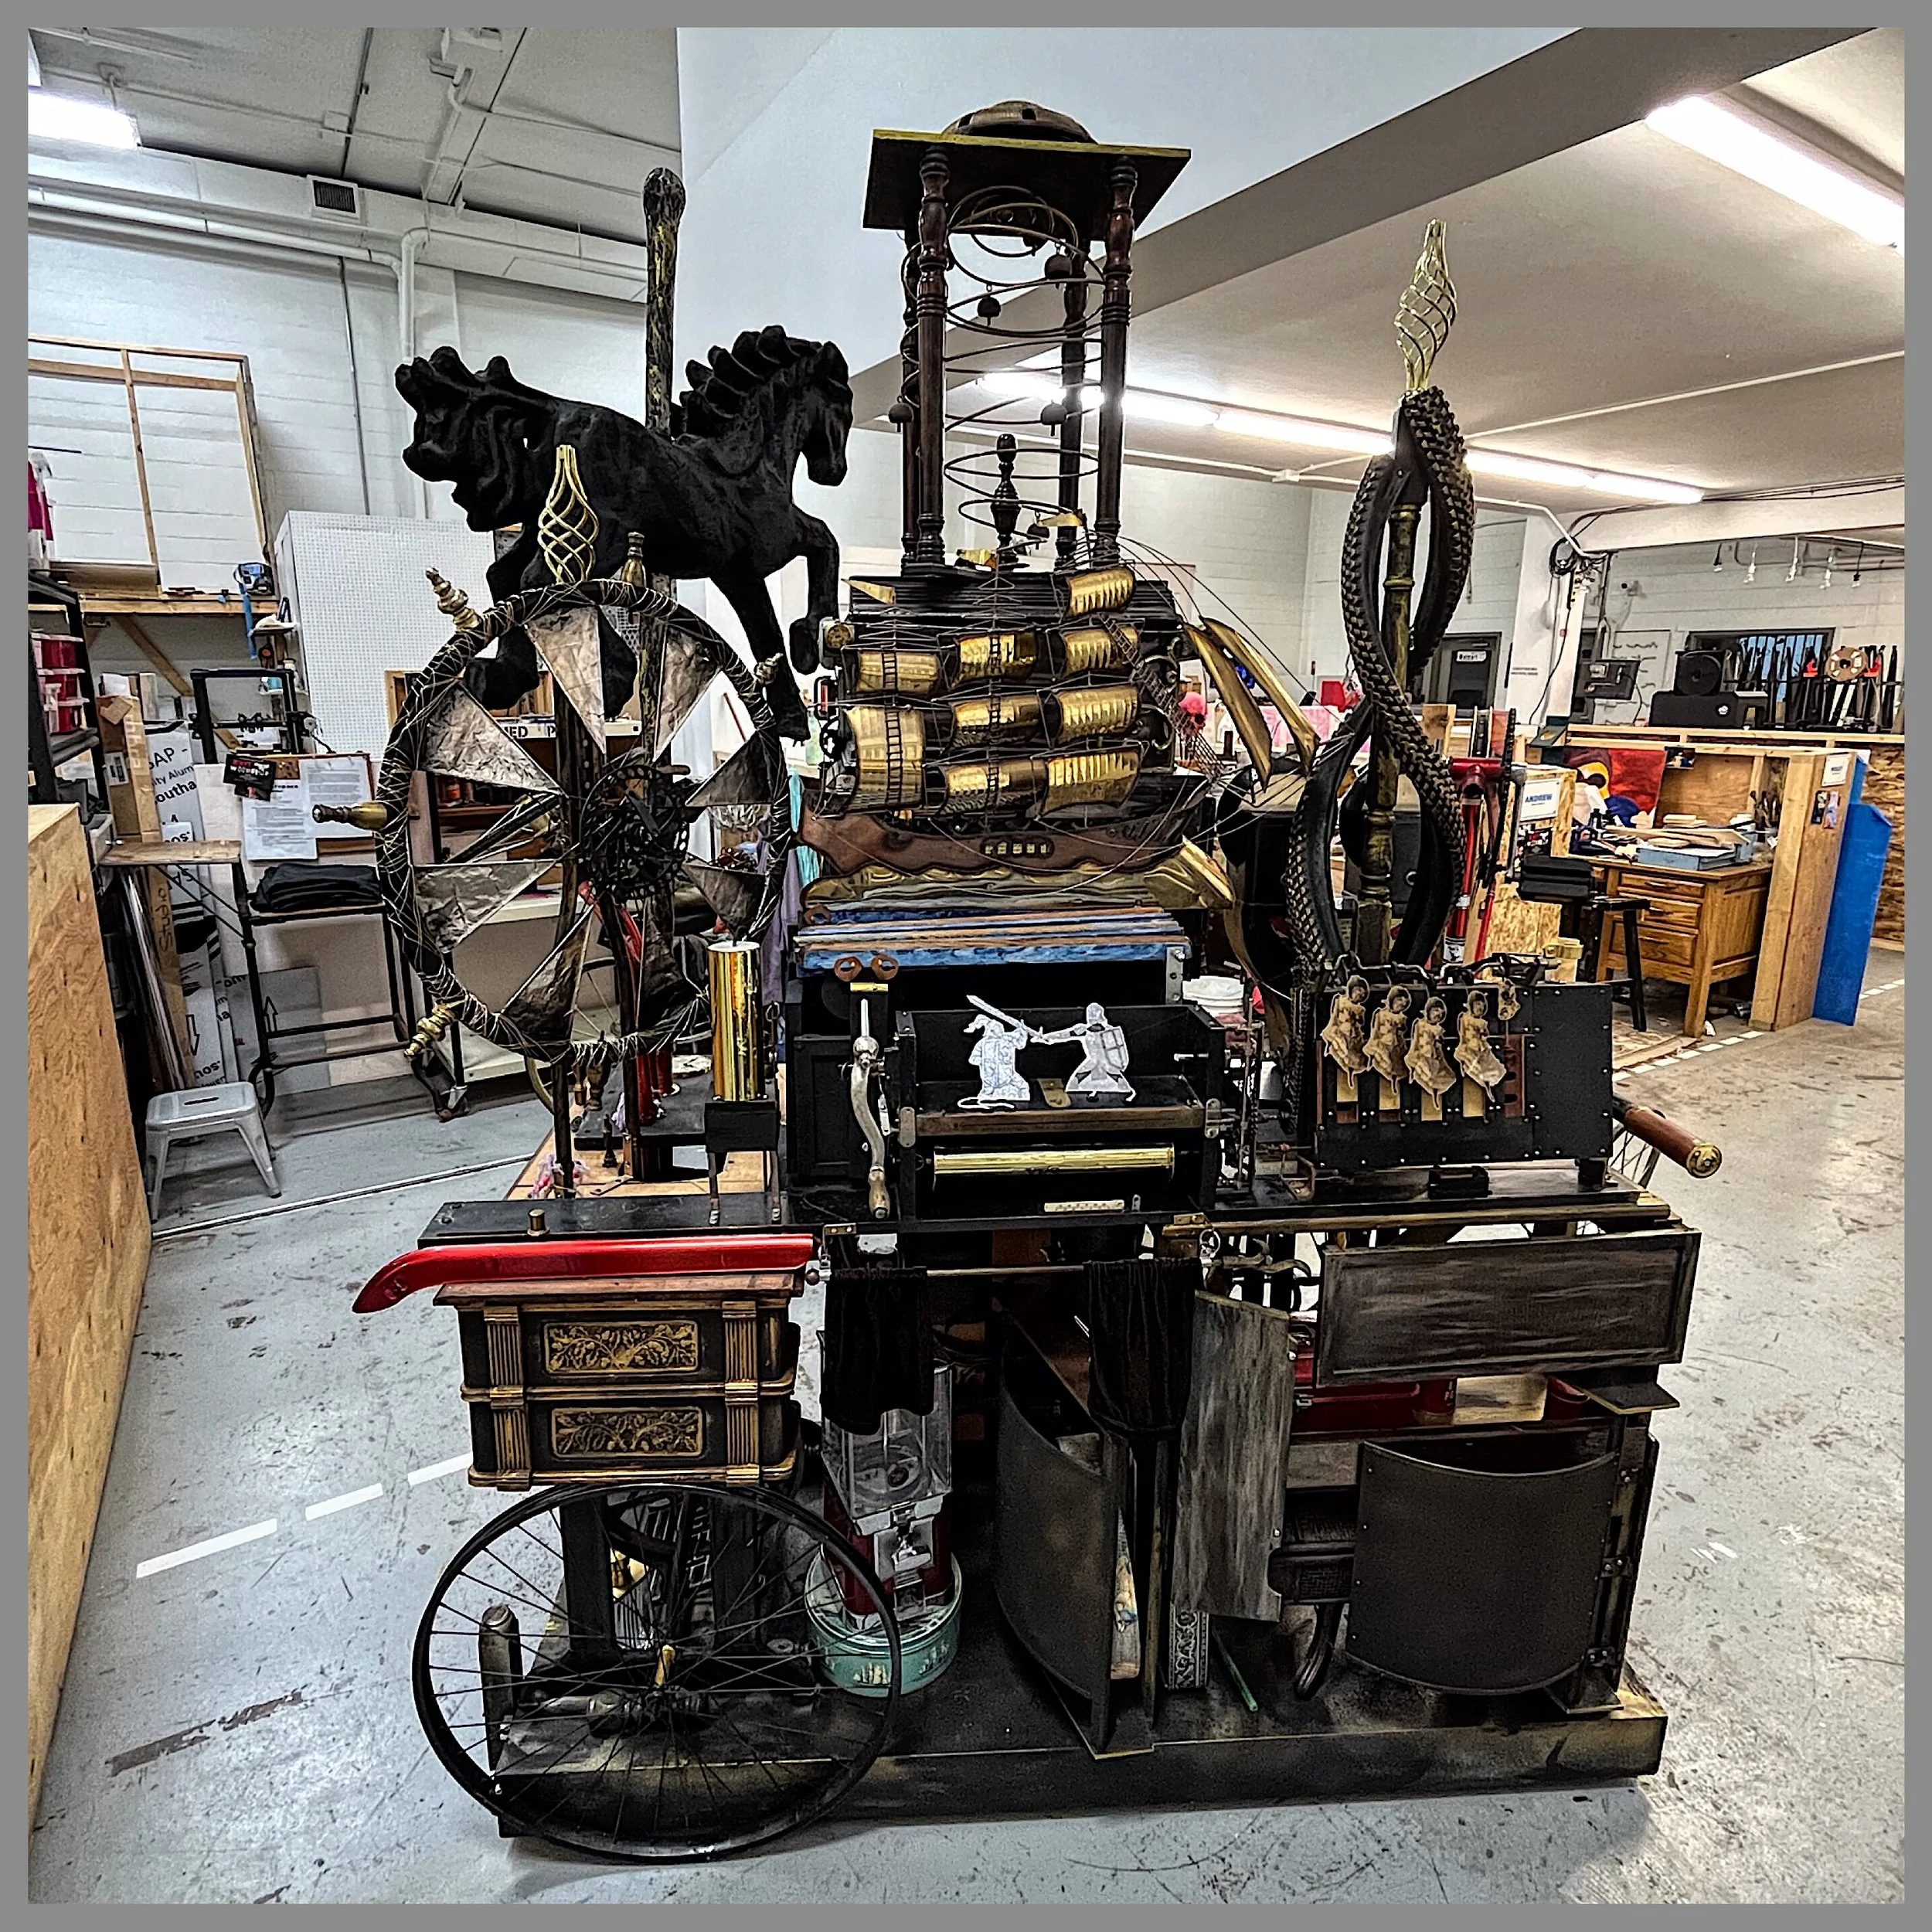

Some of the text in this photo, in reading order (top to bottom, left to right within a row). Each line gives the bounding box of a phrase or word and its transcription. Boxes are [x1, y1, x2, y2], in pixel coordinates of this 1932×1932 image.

[505, 726, 529, 737] ED
[154, 781, 198, 804] outha
[1525, 794, 1553, 803] ANDREW
[156, 887, 173, 952] Studio
